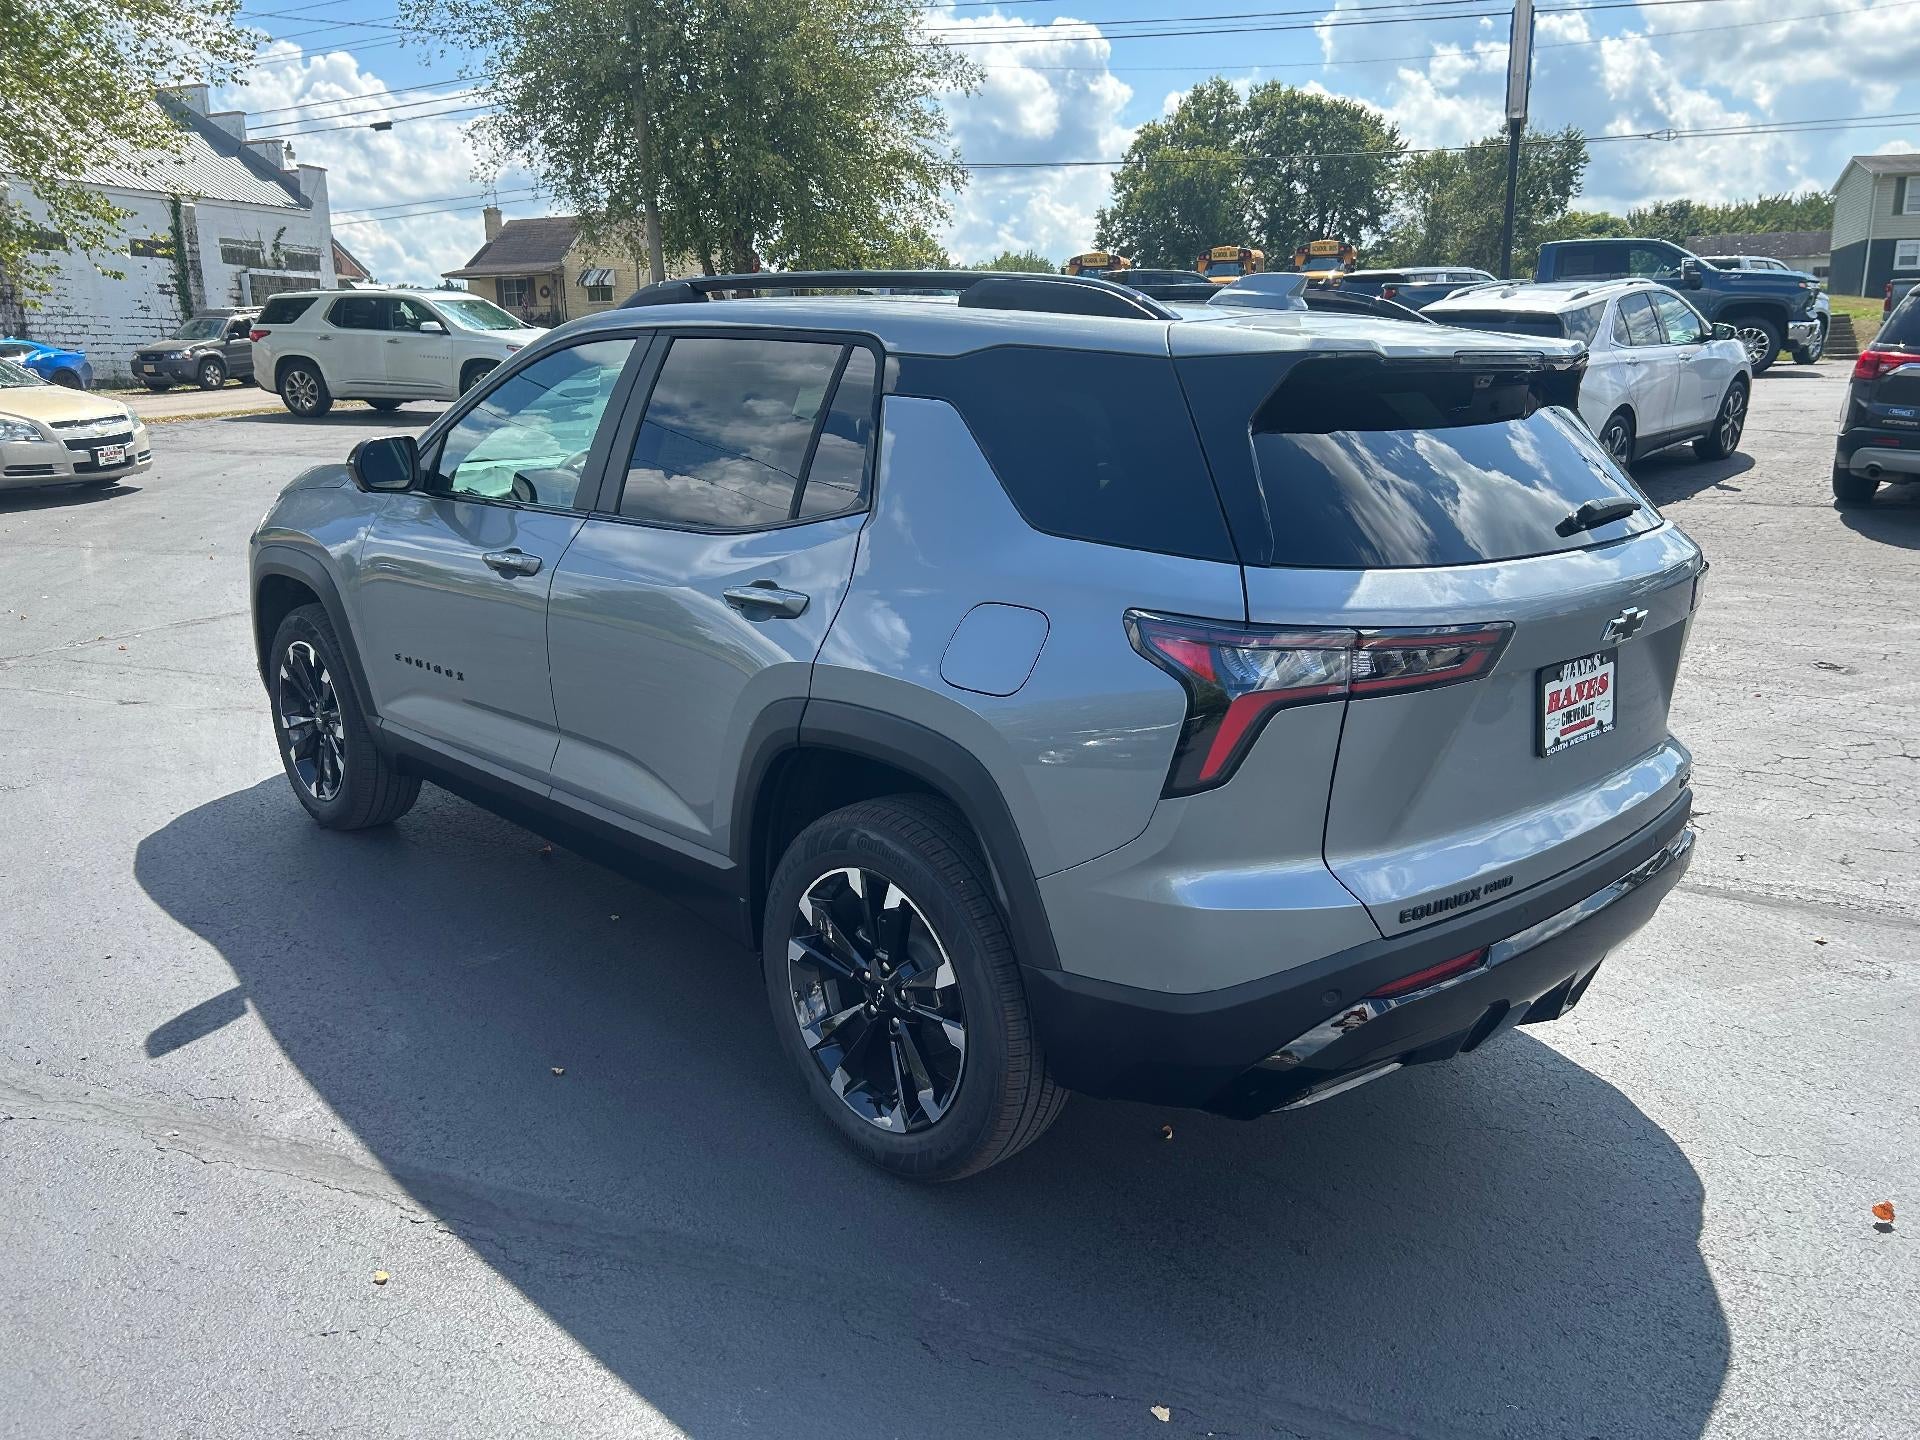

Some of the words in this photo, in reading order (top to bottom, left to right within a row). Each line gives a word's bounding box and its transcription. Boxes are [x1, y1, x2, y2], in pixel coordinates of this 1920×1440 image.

[1546, 672, 1609, 715] HANES
[1561, 701, 1595, 726] CHEVROLET
[1546, 742, 1568, 756] SOUTH
[1399, 886, 1482, 923] EQUINOX
